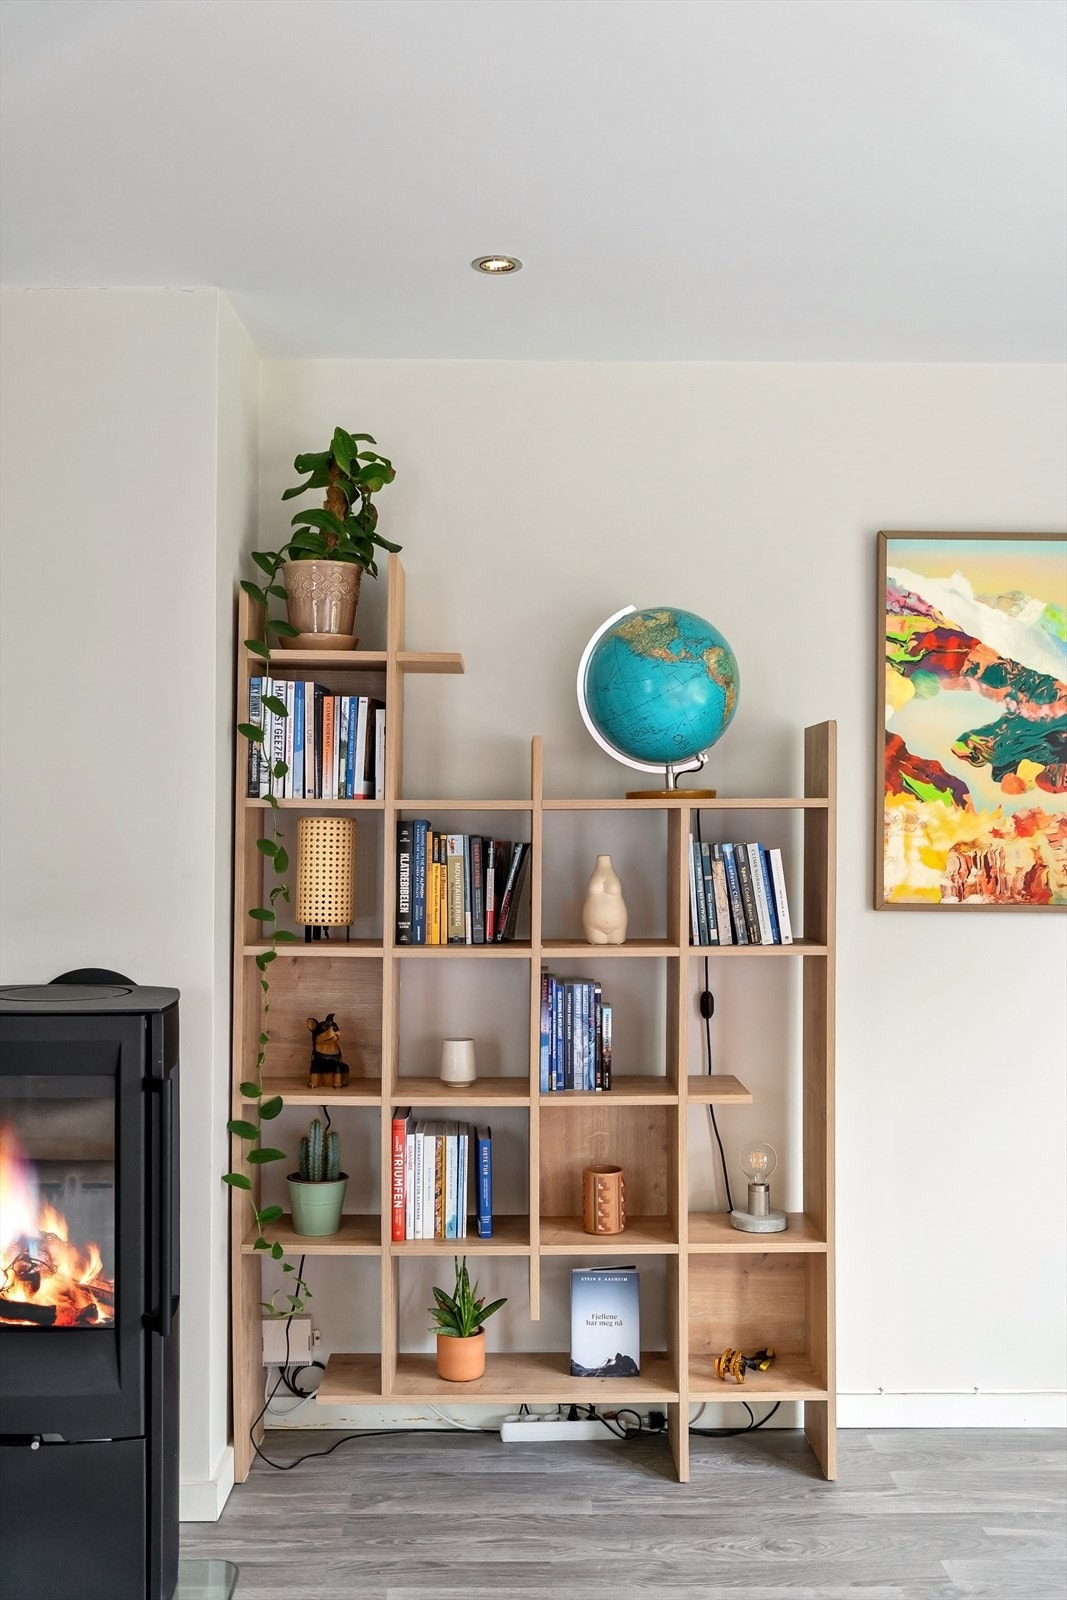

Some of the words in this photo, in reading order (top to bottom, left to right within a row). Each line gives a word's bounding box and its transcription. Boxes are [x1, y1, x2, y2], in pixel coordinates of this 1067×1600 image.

[250, 683, 260, 694] SKY
[250, 696, 260, 718] RUNNER
[275, 685, 284, 726] HAST
[400, 853, 410, 913] KLATREBIBELEN
[728, 865, 737, 890] Lofoten
[754, 869, 762, 893] NORWAY
[732, 890, 740, 912] Climbs
[740, 866, 748, 883] Spain
[746, 903, 754, 921] Blanca
[394, 1152, 404, 1208] TRIUMFEN
